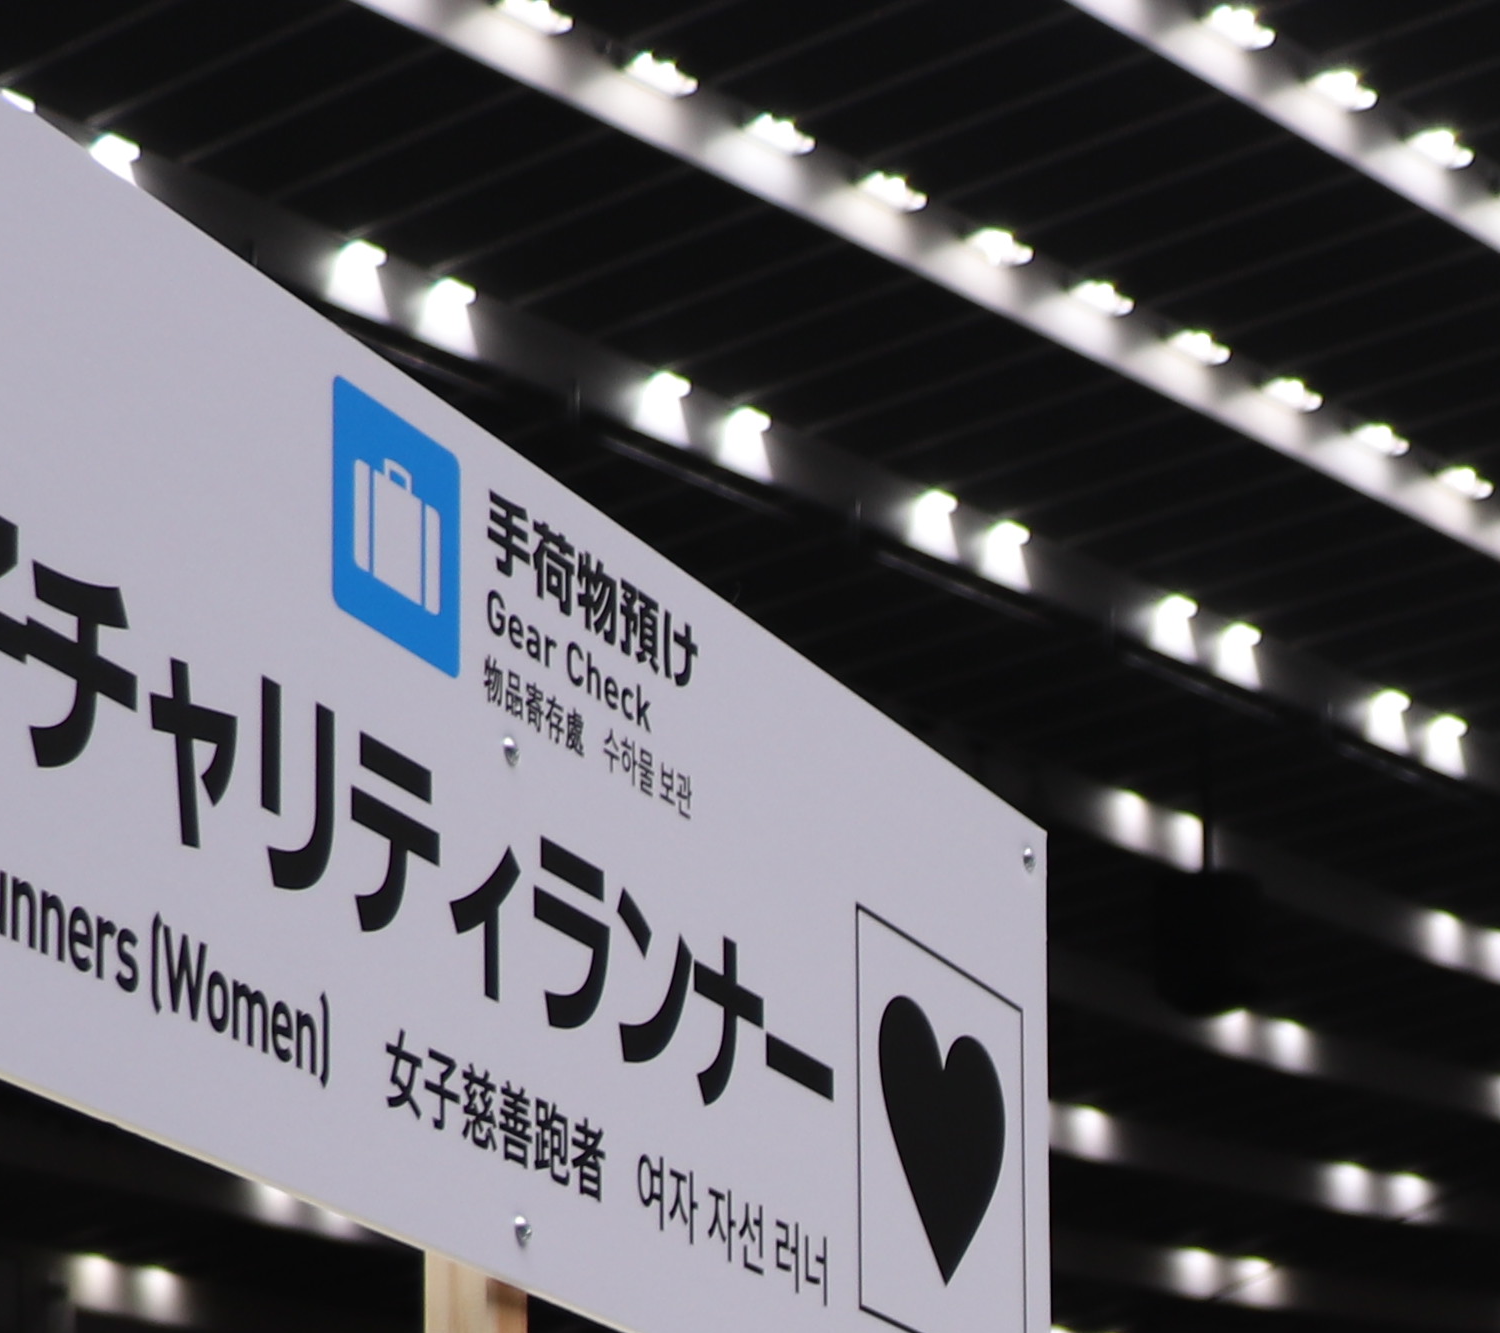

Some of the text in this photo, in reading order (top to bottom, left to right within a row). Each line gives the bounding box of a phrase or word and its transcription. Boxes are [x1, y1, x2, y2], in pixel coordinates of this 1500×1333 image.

[486, 589, 652, 734] Gear Check
[487, 488, 699, 687] 手荷物預け
[603, 728, 692, 820] 수하물 보관
[150, 912, 331, 1089] (Women)
[385, 1029, 606, 1202] 女子慈善跑者
[637, 1154, 828, 1307] 여자 자선 러너
